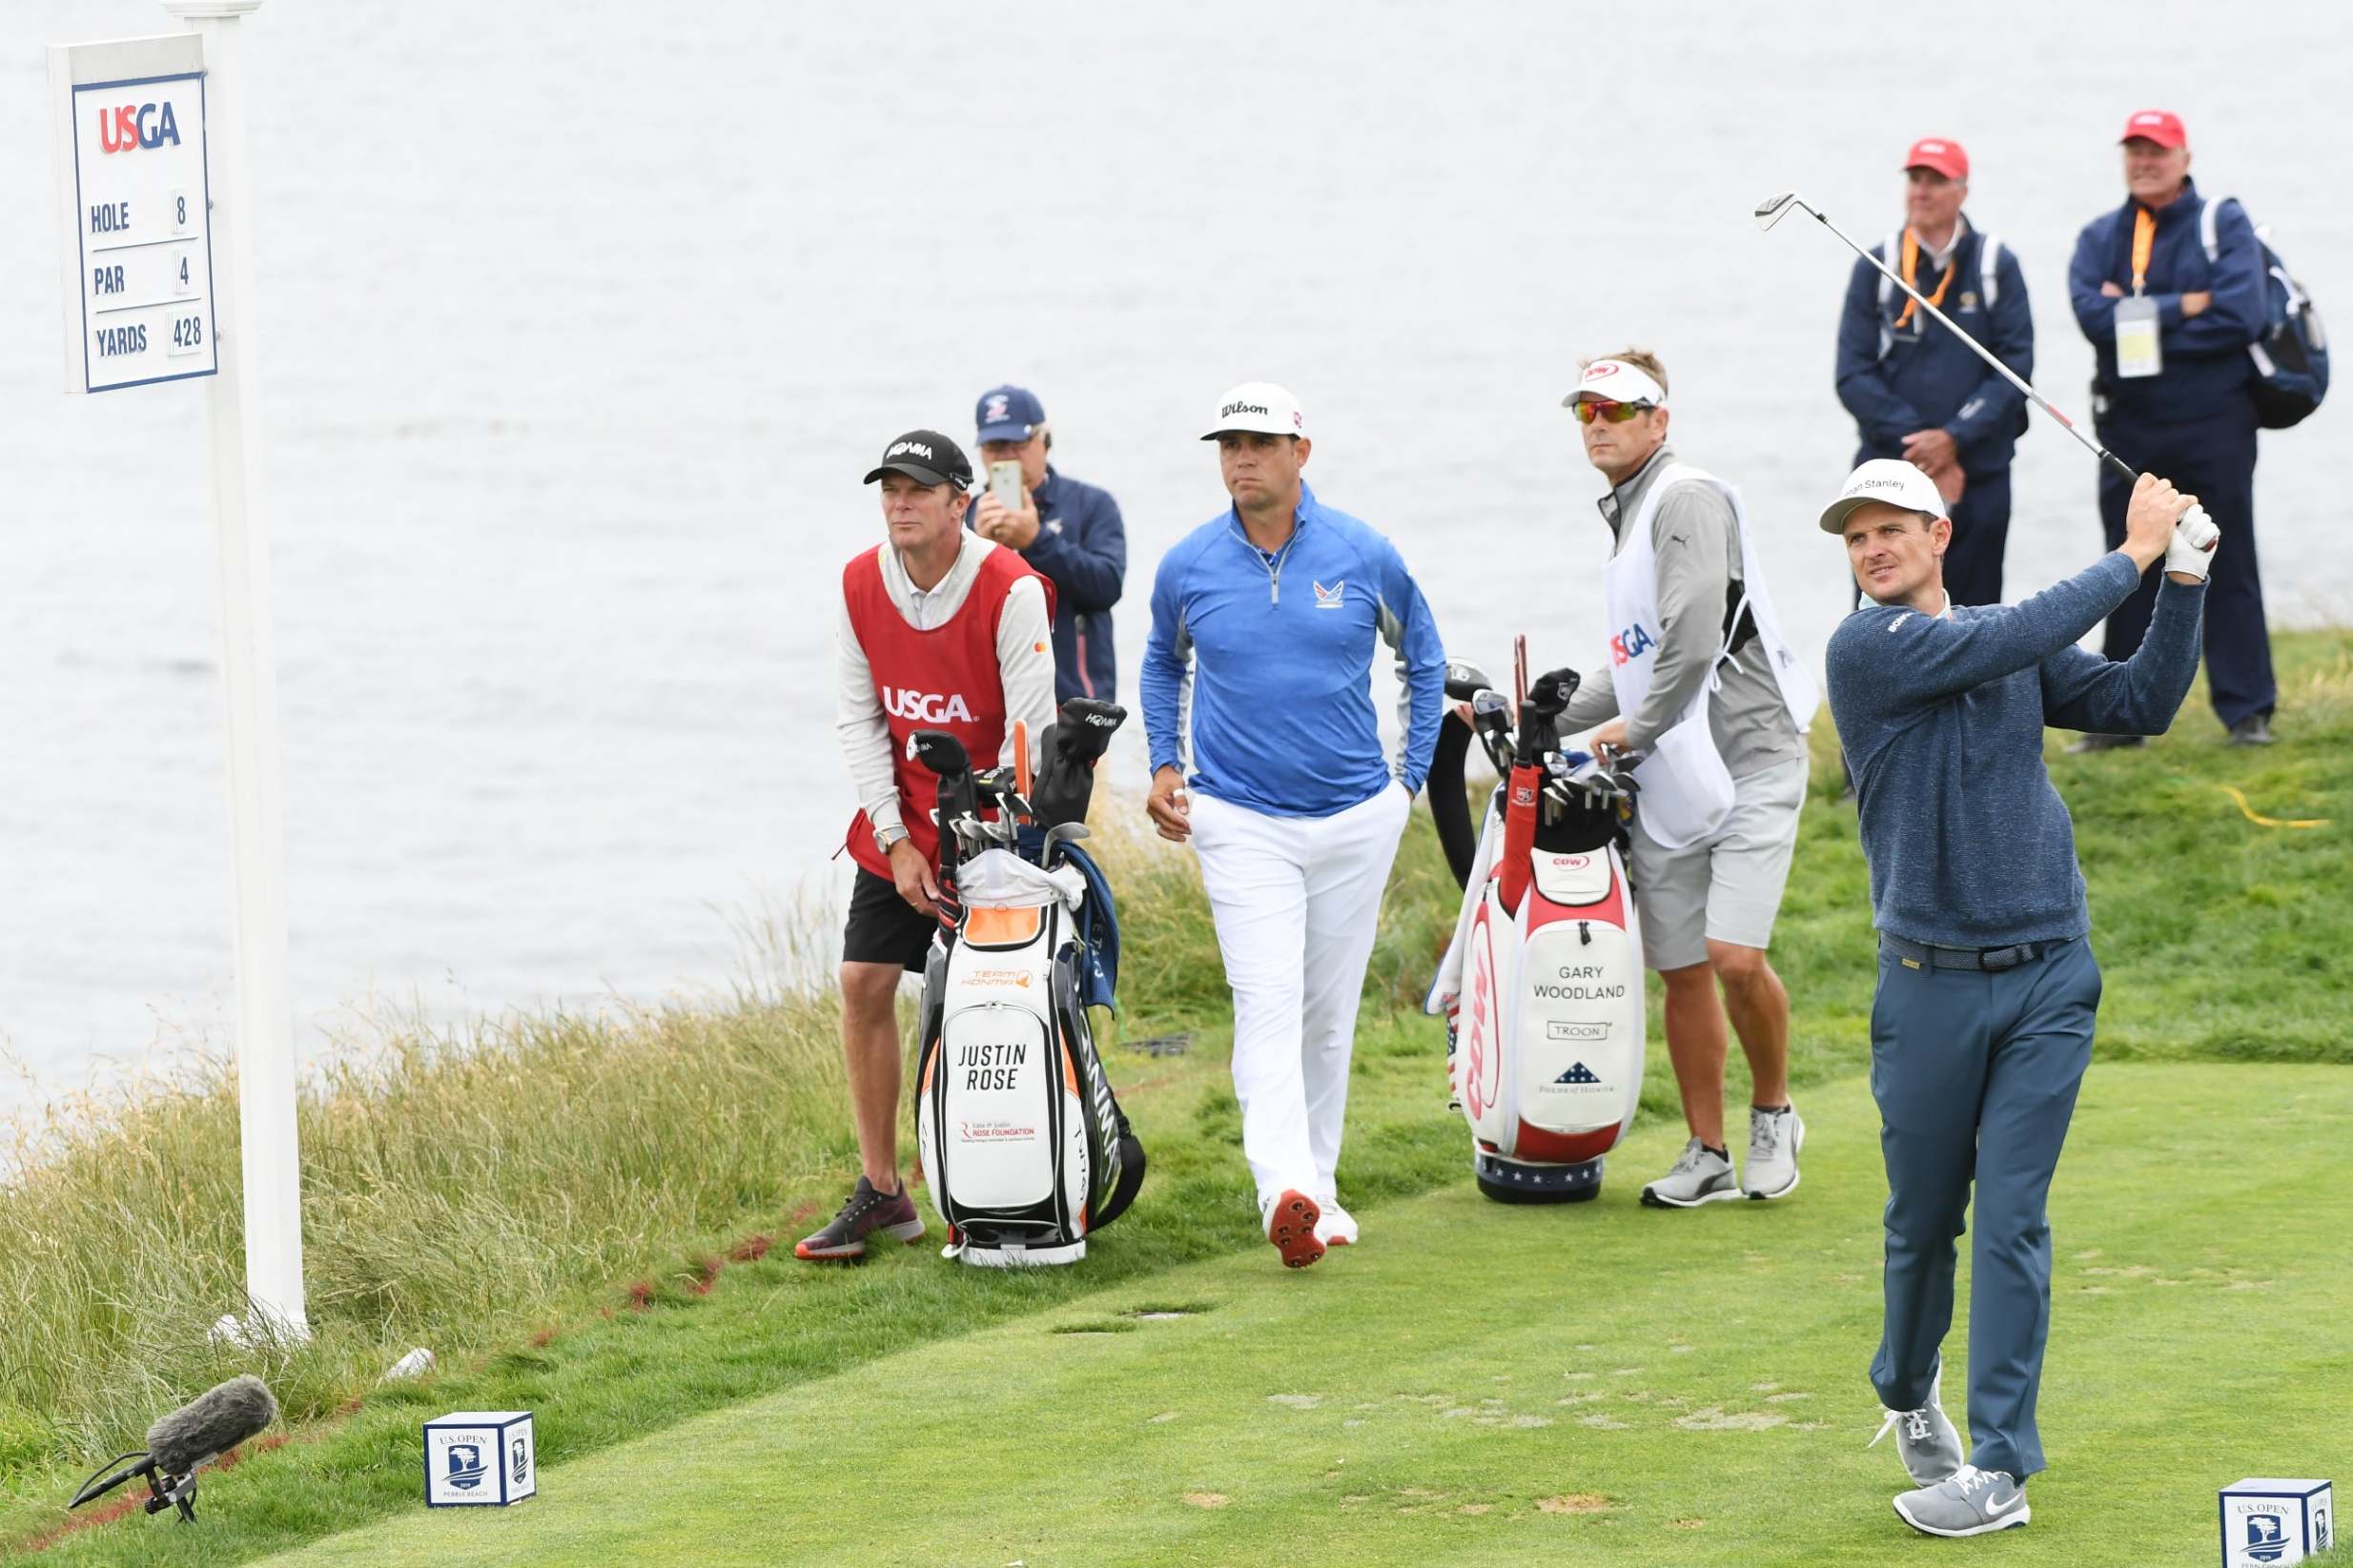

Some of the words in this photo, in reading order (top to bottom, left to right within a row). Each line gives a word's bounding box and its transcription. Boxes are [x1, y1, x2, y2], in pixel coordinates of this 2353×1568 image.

[100, 101, 181, 153] USGA
[91, 202, 130, 234] HOLE
[176, 196, 186, 225] 8
[95, 265, 125, 295] PAR
[179, 256, 189, 284] 4
[96, 324, 147, 356] YARDS
[174, 316, 202, 347] 428
[1221, 400, 1268, 418] Wilson
[1865, 479, 1905, 491] Stanley
[883, 685, 972, 723] USGA
[1552, 858, 1581, 866] CDW
[1559, 966, 1604, 979] GARY
[1533, 984, 1626, 1000] WOODLAND
[1555, 1026, 1601, 1037] TROON
[957, 1044, 1027, 1067] JUSTIN
[966, 1069, 1018, 1090] ROSE
[992, 1128, 1034, 1136] FOUNDATION
[457, 1434, 487, 1445] OPEN
[2257, 1502, 2289, 1516] OPEN
